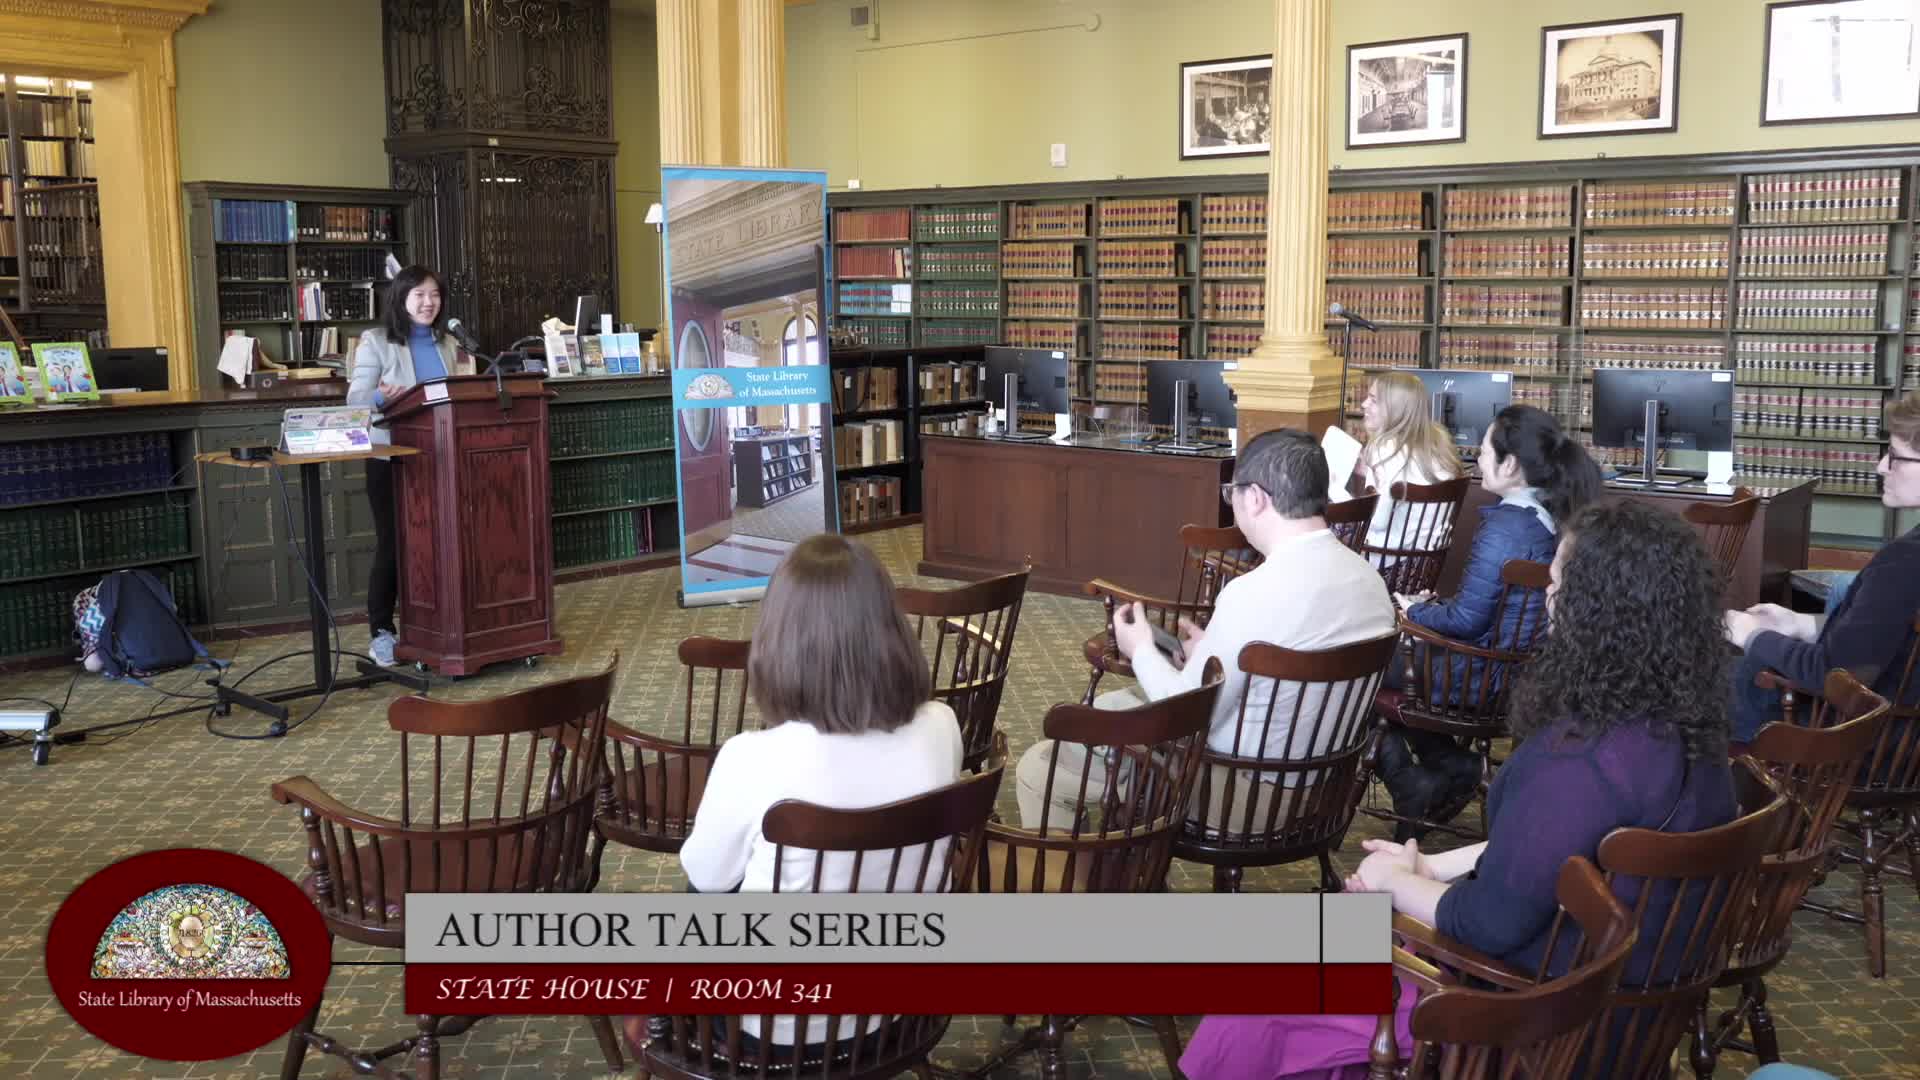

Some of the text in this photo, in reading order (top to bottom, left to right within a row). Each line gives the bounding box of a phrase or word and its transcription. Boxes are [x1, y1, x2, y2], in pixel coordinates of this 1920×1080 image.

[739, 200, 822, 240] LIBRARY
[745, 370, 809, 382] State Library
[739, 385, 817, 399] of Massachusetts
